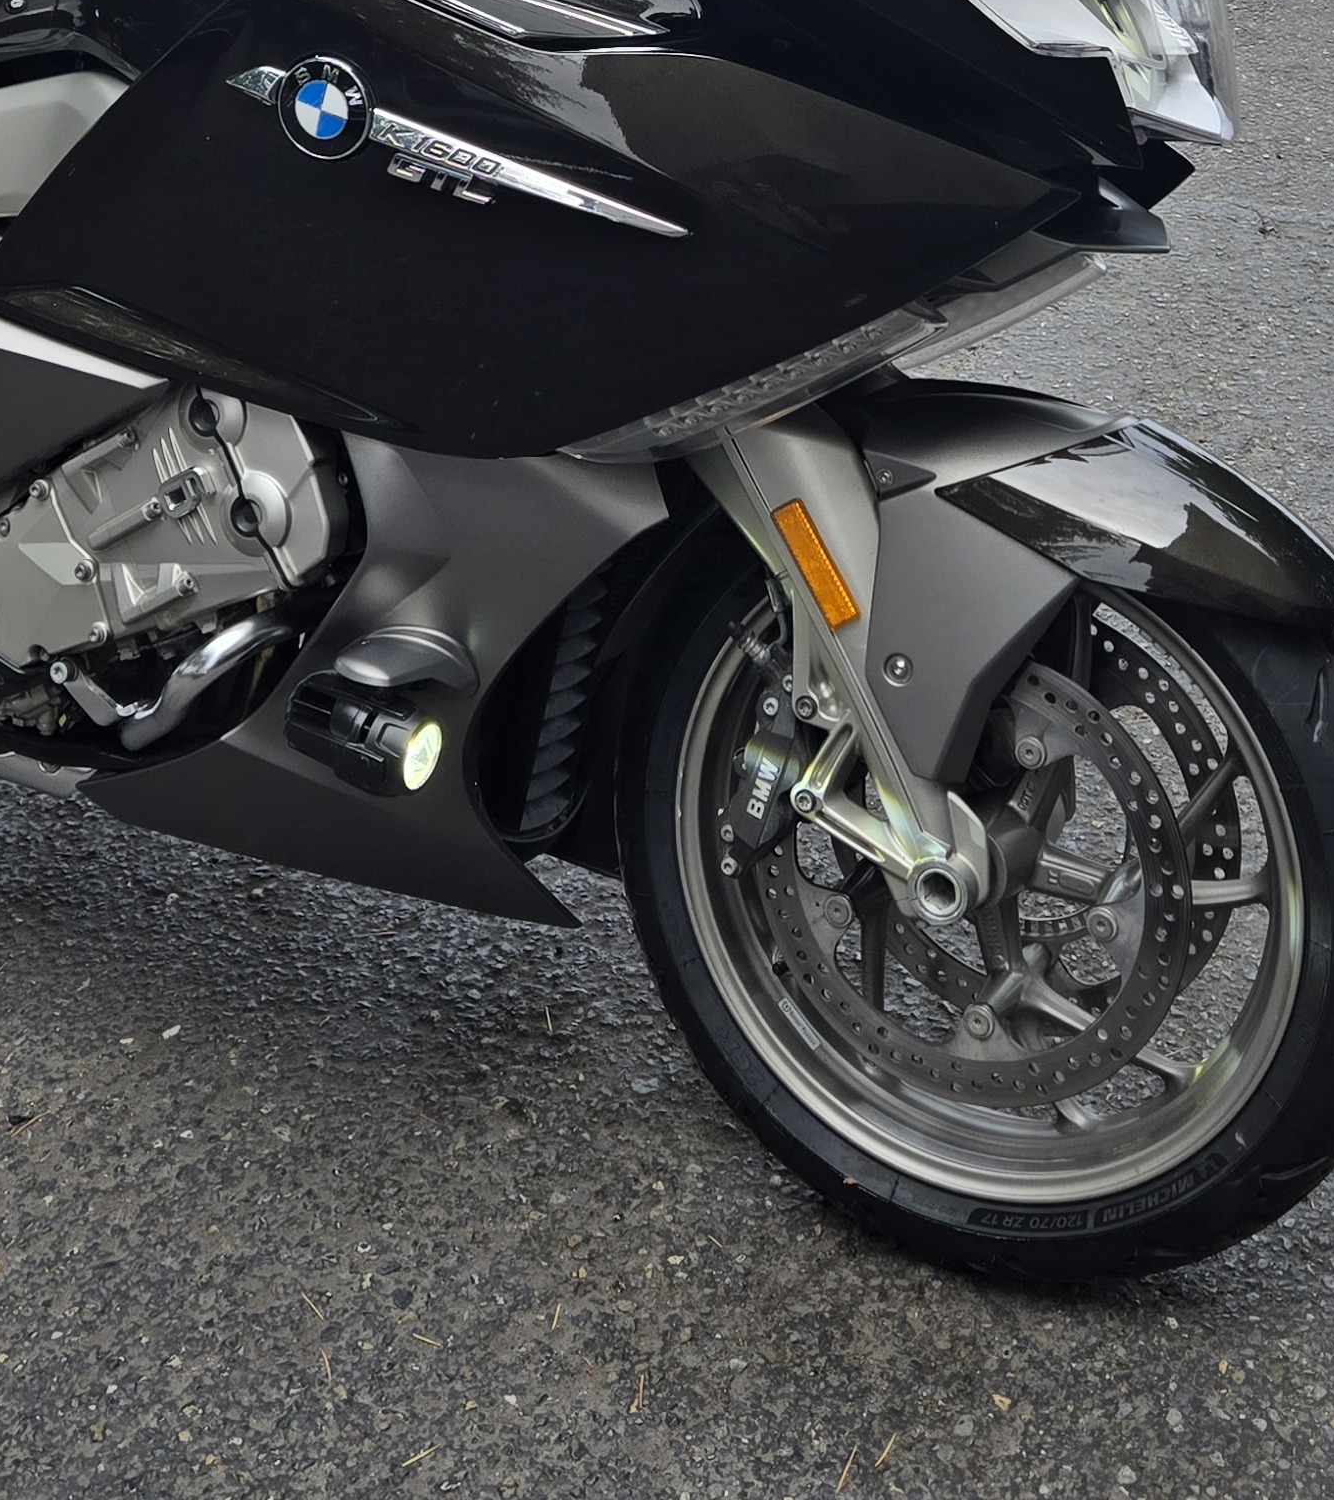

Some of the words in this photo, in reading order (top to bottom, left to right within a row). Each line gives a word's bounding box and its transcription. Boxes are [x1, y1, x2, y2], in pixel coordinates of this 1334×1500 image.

[295, 64, 363, 107] BMW
[386, 152, 497, 205] GTL
[745, 756, 781, 820] BMW
[980, 1212, 1000, 1225] 17
[1102, 1173, 1195, 1223] MICHELIN
[1002, 1214, 1024, 1229] ZR
[1029, 1213, 1083, 1230] 120/70
